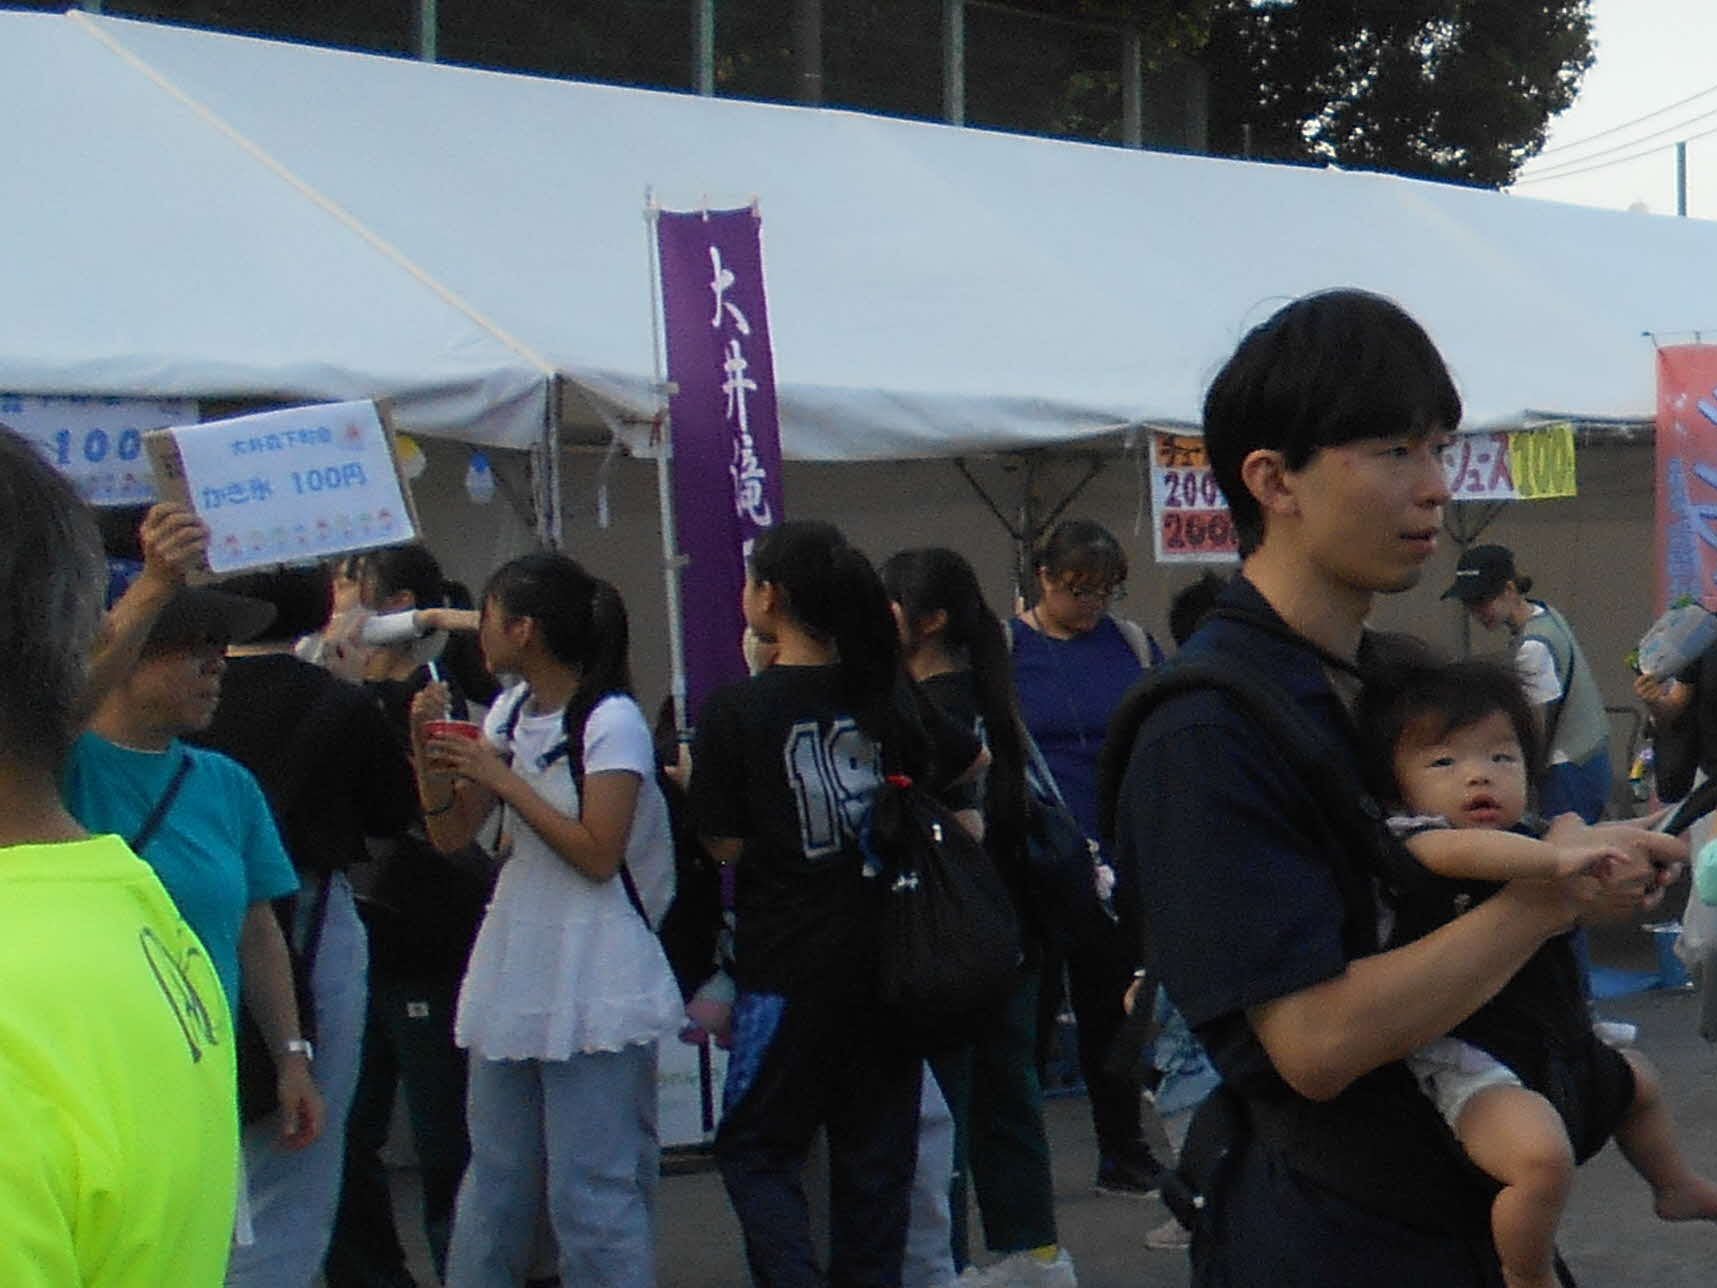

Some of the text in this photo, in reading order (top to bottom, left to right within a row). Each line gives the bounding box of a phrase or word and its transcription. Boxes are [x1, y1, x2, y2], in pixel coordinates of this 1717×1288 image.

[291, 461, 369, 495] 100円
[708, 245, 774, 560] 大井滝
